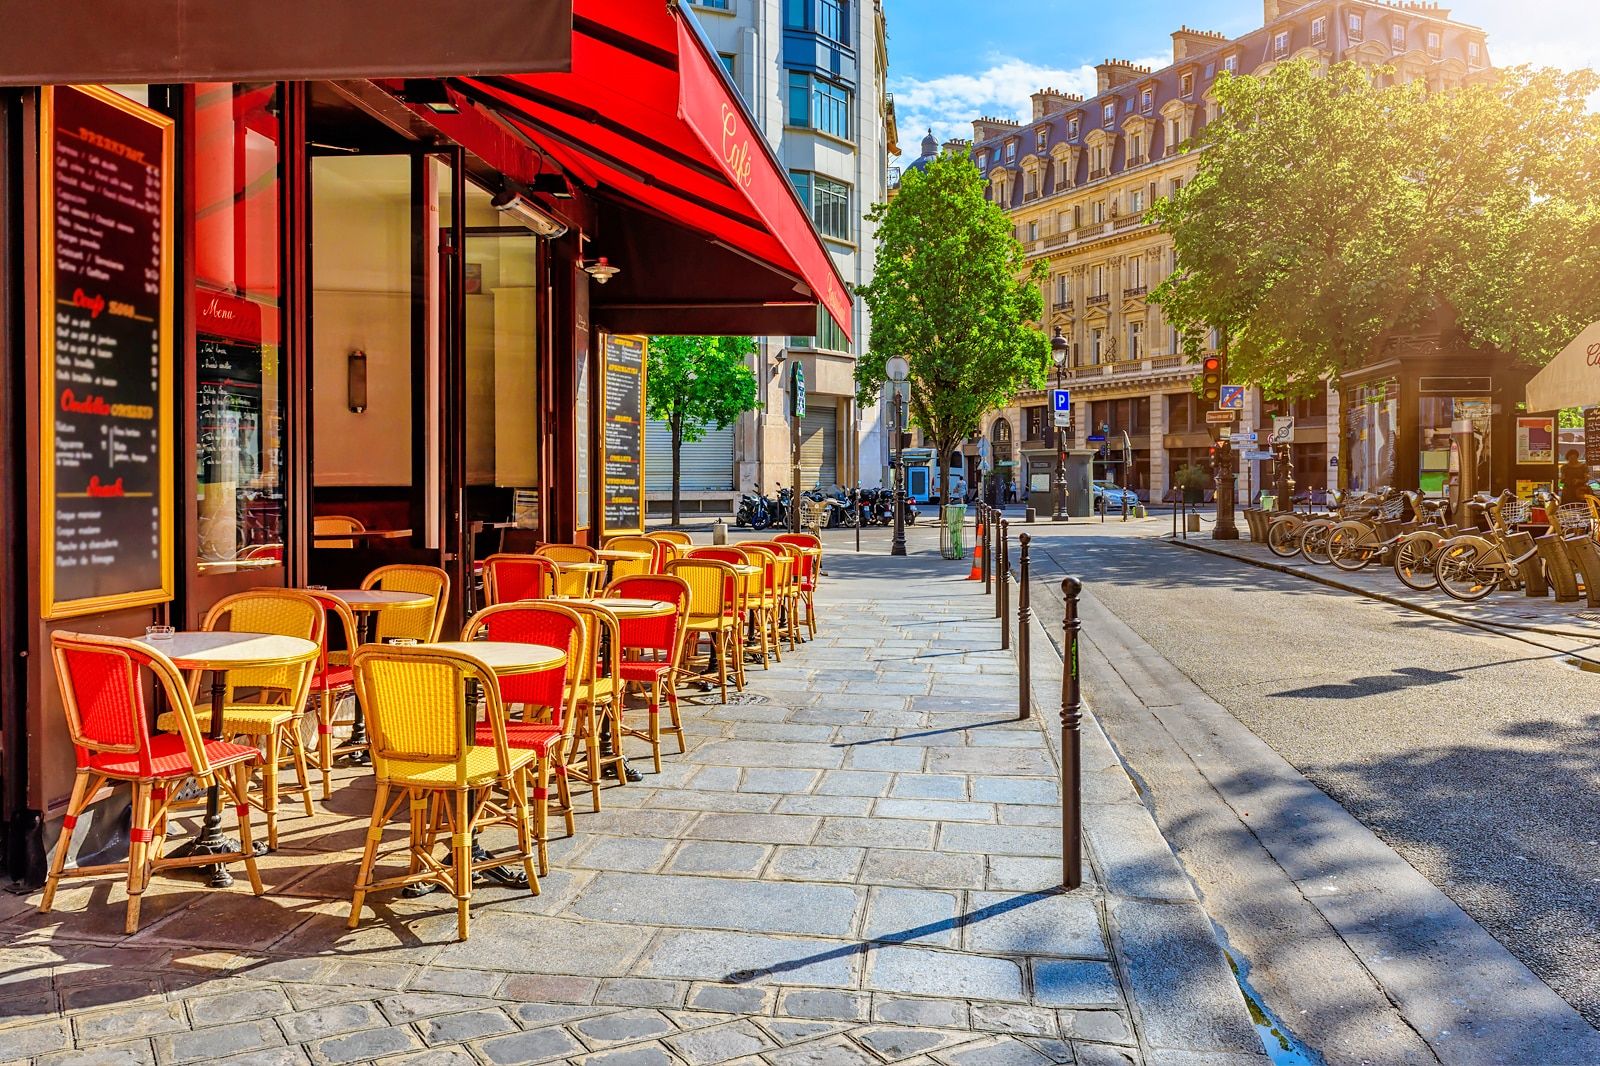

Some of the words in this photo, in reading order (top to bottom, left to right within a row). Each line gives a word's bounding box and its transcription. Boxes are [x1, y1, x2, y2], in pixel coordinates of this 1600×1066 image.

[721, 102, 752, 187] Café
[203, 298, 236, 320] Menu
[1058, 394, 1066, 408] P
